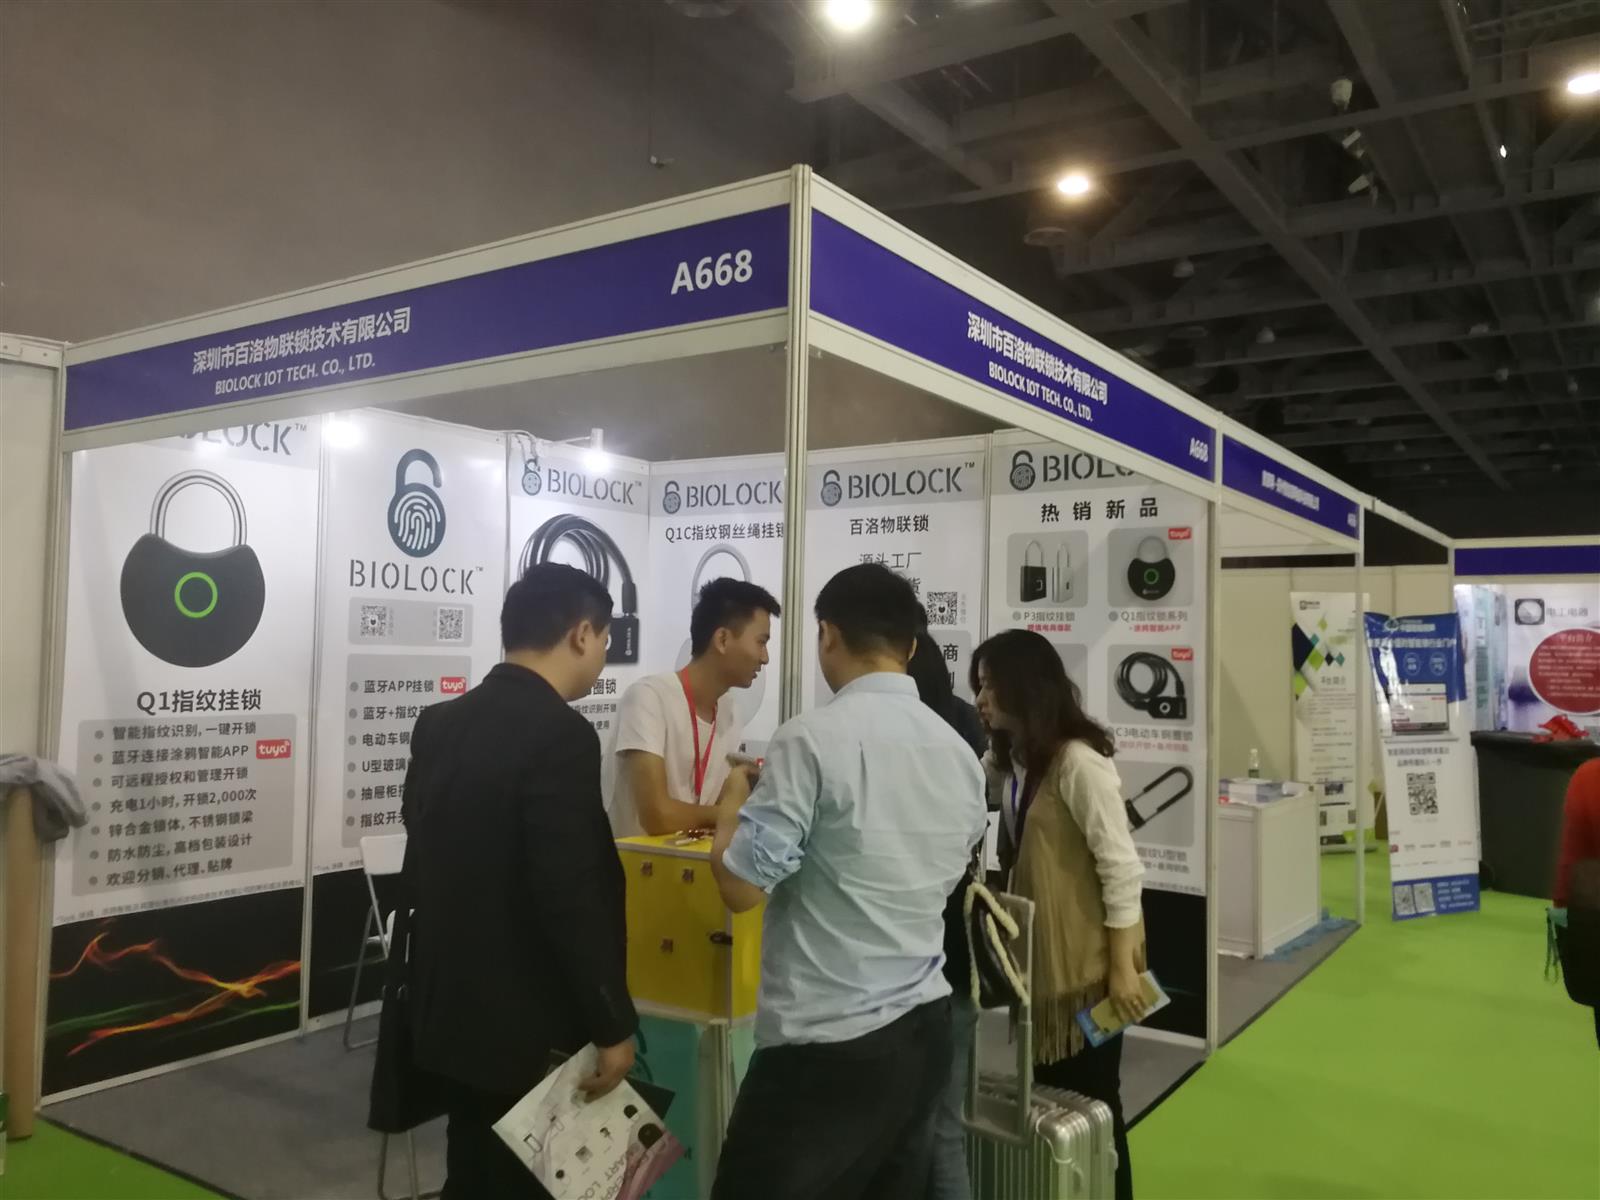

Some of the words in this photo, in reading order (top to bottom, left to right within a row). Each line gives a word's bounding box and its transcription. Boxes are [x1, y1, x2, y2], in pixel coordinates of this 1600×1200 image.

[670, 249, 753, 296] A668
[192, 306, 412, 375] 深圳市百洛物联锁技术有限公司
[967, 311, 1108, 406] 深圳市百洛物联锁技术有限公司
[214, 375, 262, 396] BIOLOCK
[263, 369, 284, 386] IOT
[287, 363, 319, 382] TECH.
[321, 358, 345, 377] CO.,
[348, 352, 376, 372] LTD.
[988, 360, 1026, 394] BIOLOCK
[1026, 378, 1041, 399] IOT
[1078, 403, 1094, 422] LTD.
[547, 468, 635, 506] BIOLOCK
[686, 480, 783, 508] BIOLOCK
[848, 466, 963, 500] BIOLOCK
[1041, 497, 1159, 523] 热销新品
[849, 513, 930, 536] 百洛物联锁
[349, 559, 474, 596] BIOLOCK
[363, 679, 435, 694] 蓝牙APP挂锁
[586, 678, 617, 695] 圈锁
[136, 687, 263, 716] Q1指纹挂锁
[363, 704, 428, 721] 蓝牙+指纹
[111, 744, 249, 766] 蓝牙连接涂鸦智能APP
[258, 742, 289, 758] tuya
[111, 766, 249, 789] 可远程授权和管理开锁
